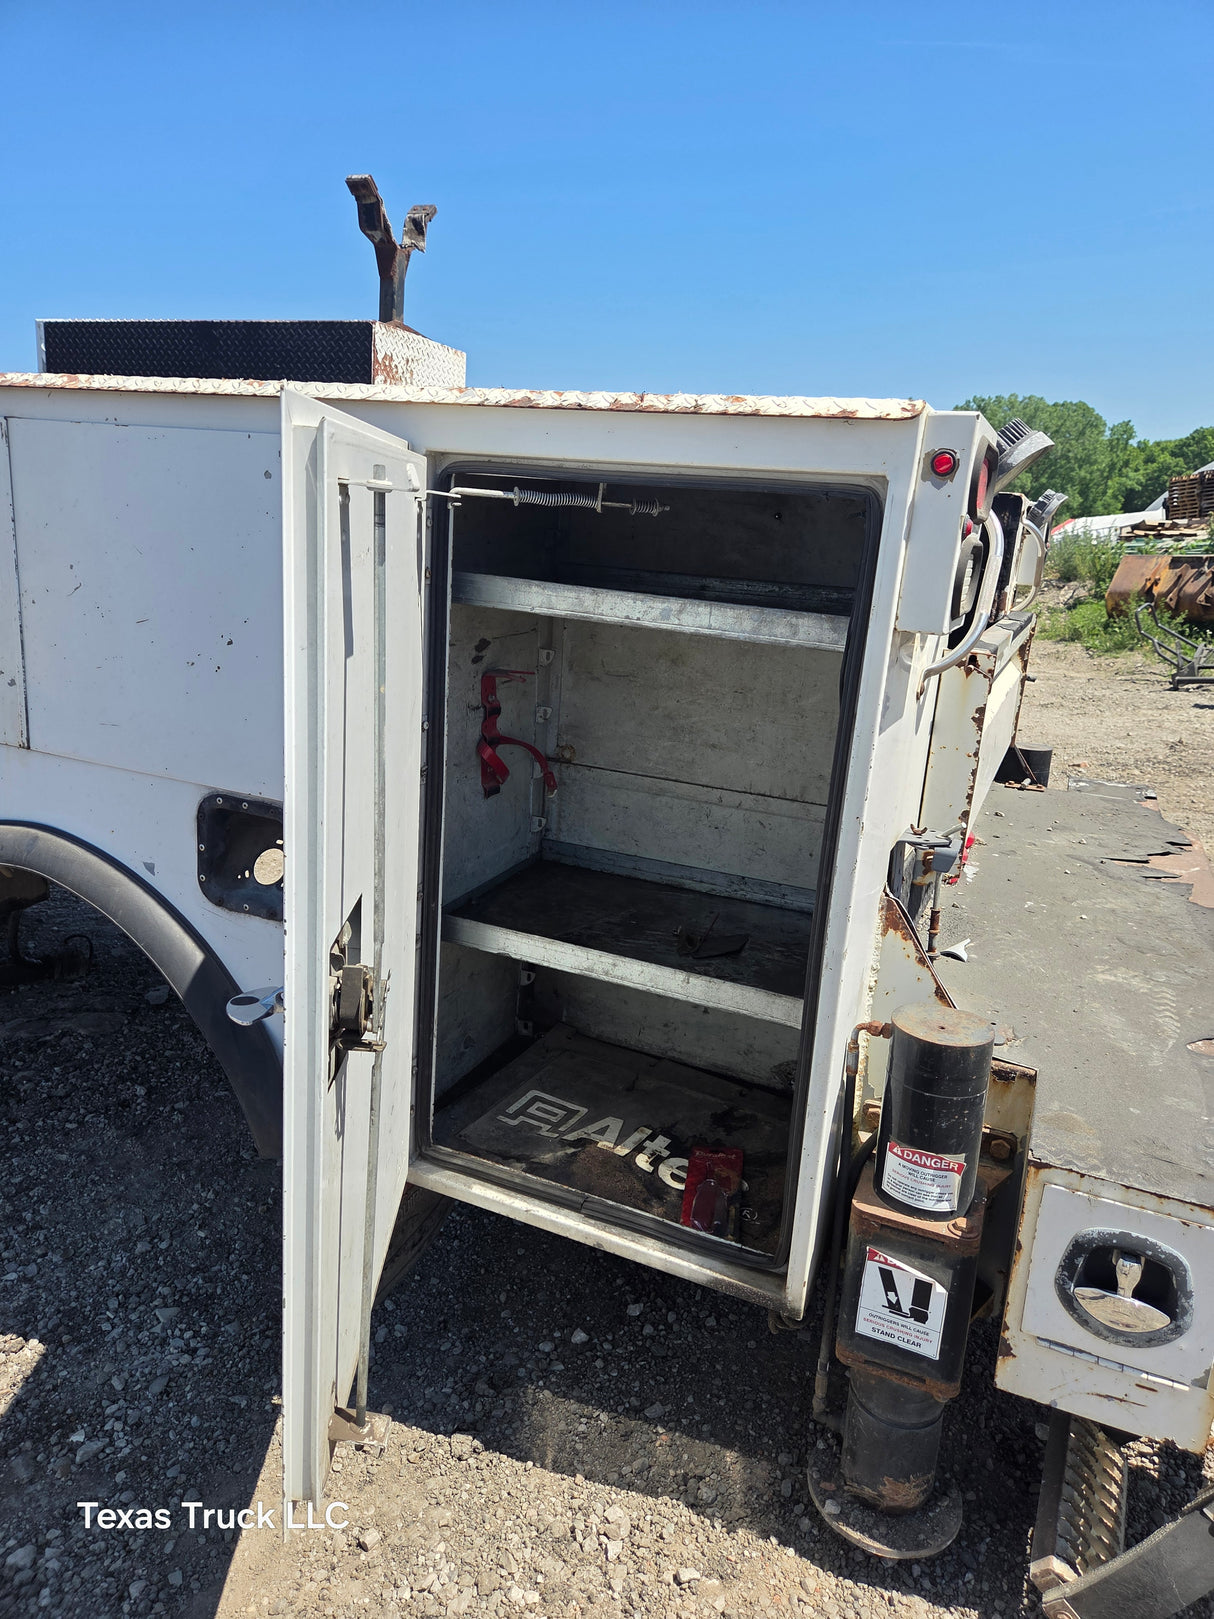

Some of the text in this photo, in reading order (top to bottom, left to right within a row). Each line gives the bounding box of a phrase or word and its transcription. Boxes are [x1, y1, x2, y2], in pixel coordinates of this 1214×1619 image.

[561, 1116, 749, 1192] Alte
[903, 1150, 959, 1171] DANGER
[892, 1168, 909, 1180] SERIOUS
[910, 1178, 935, 1187] CRUSHING
[902, 1164, 919, 1174] MOVING
[920, 1171, 947, 1179] OUTRIGGER
[908, 1171, 919, 1179] WILL
[863, 1317, 932, 1343] SERIOUS CRUSHING INJURY
[868, 1312, 930, 1336] OUTRIGGERS WILL CAUSE
[871, 1326, 922, 1348] STAND CLEAR
